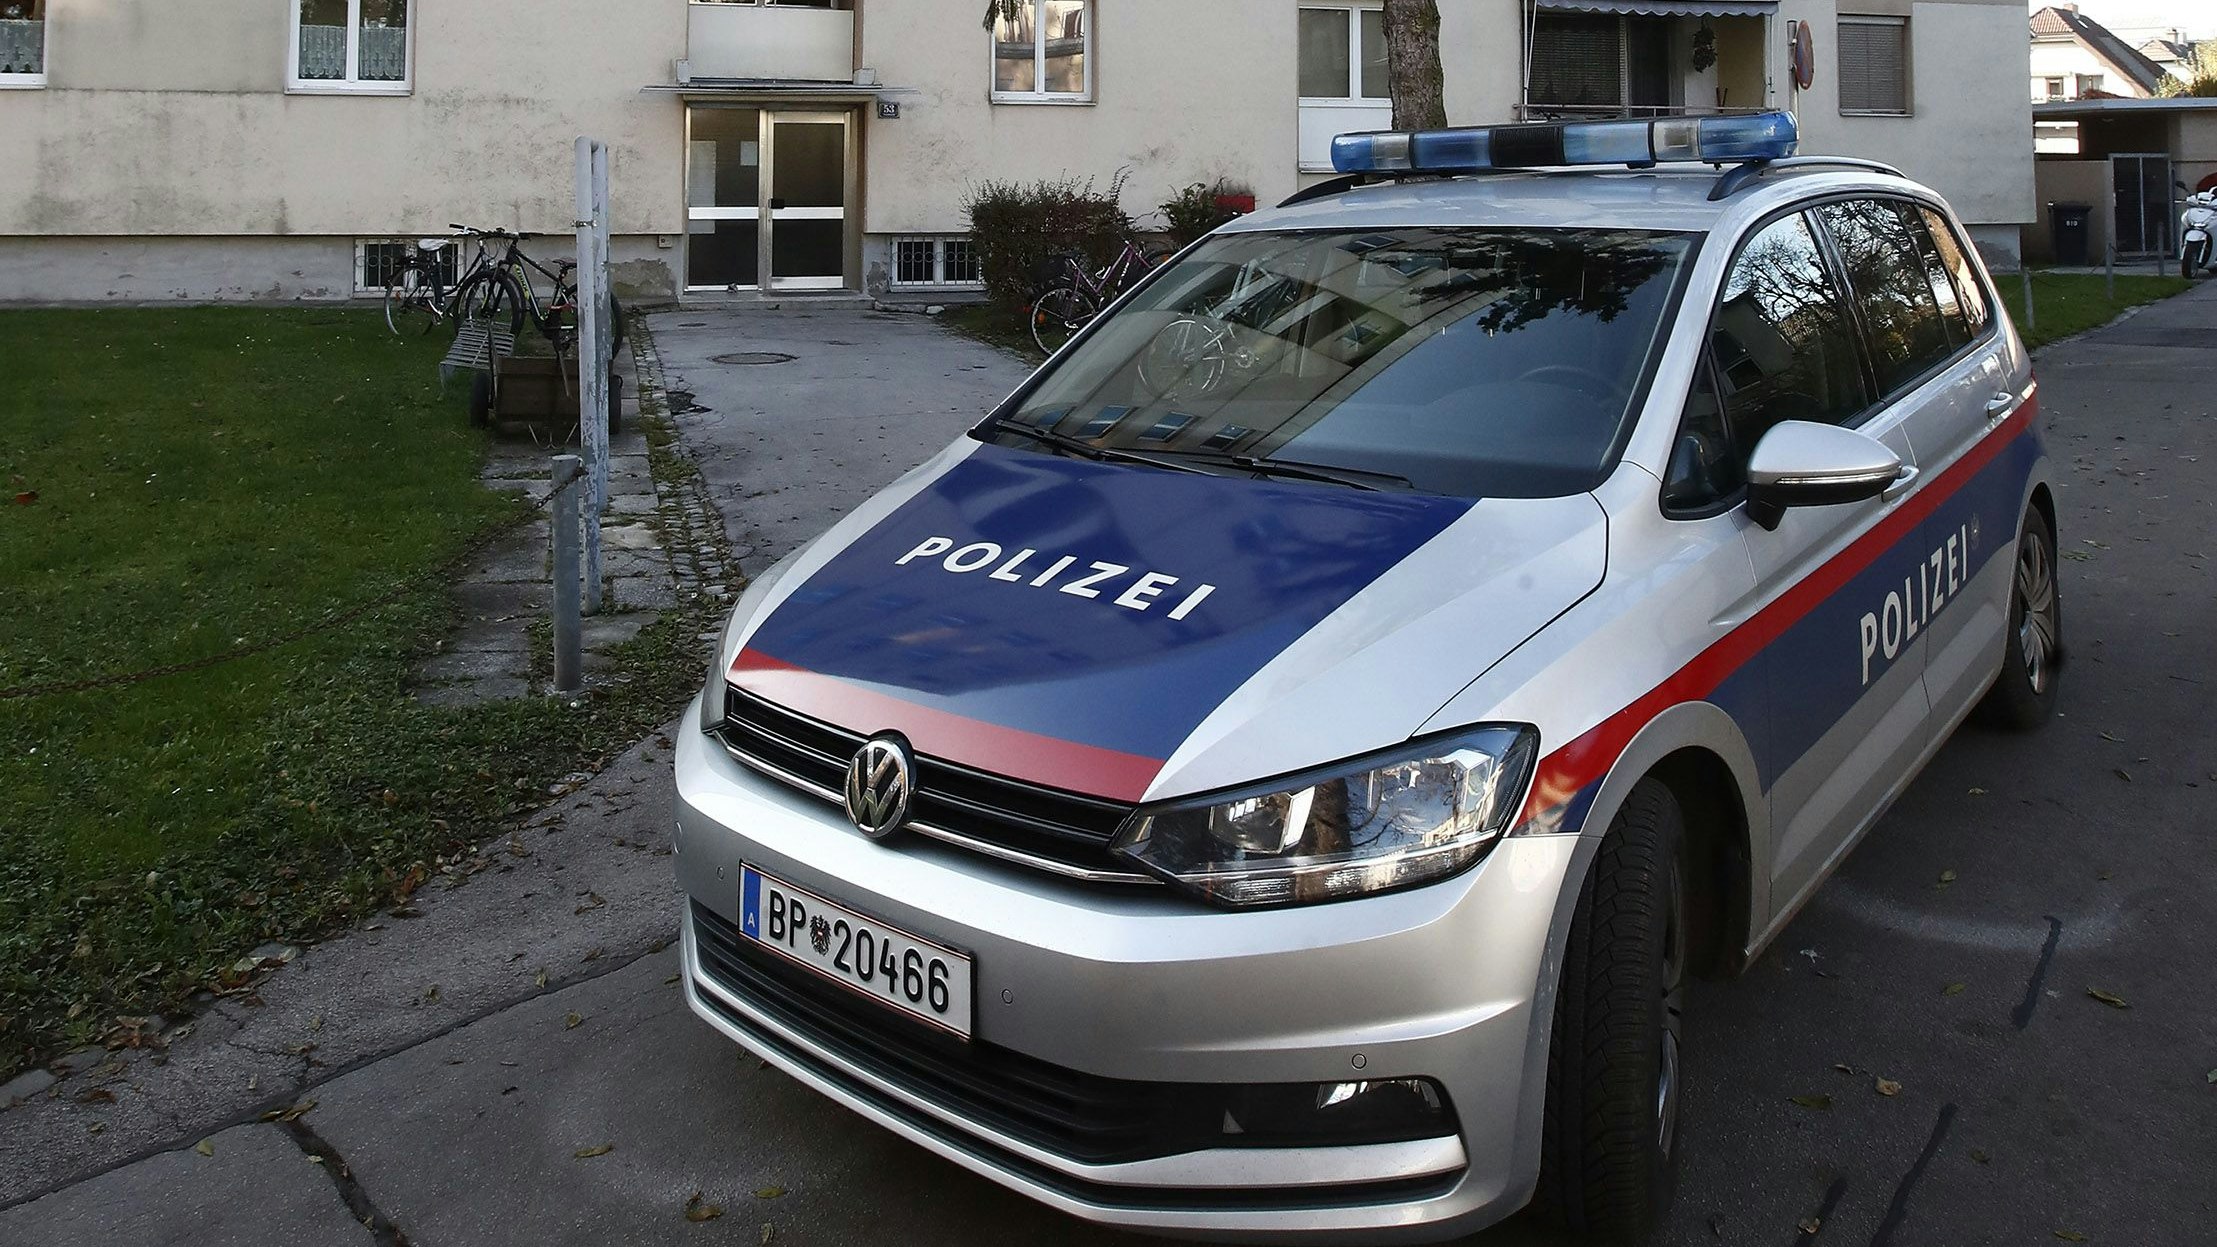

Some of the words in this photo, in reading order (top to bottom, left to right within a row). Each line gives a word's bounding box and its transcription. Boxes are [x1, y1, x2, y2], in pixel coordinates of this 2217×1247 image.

[883, 104, 895, 113] 53
[895, 536, 1216, 621] POLIZEI
[1860, 524, 1967, 686] POLIZEI
[846, 740, 909, 838] VW
[747, 912, 756, 929] A
[769, 888, 807, 948] BP
[833, 918, 949, 1014] 20466
